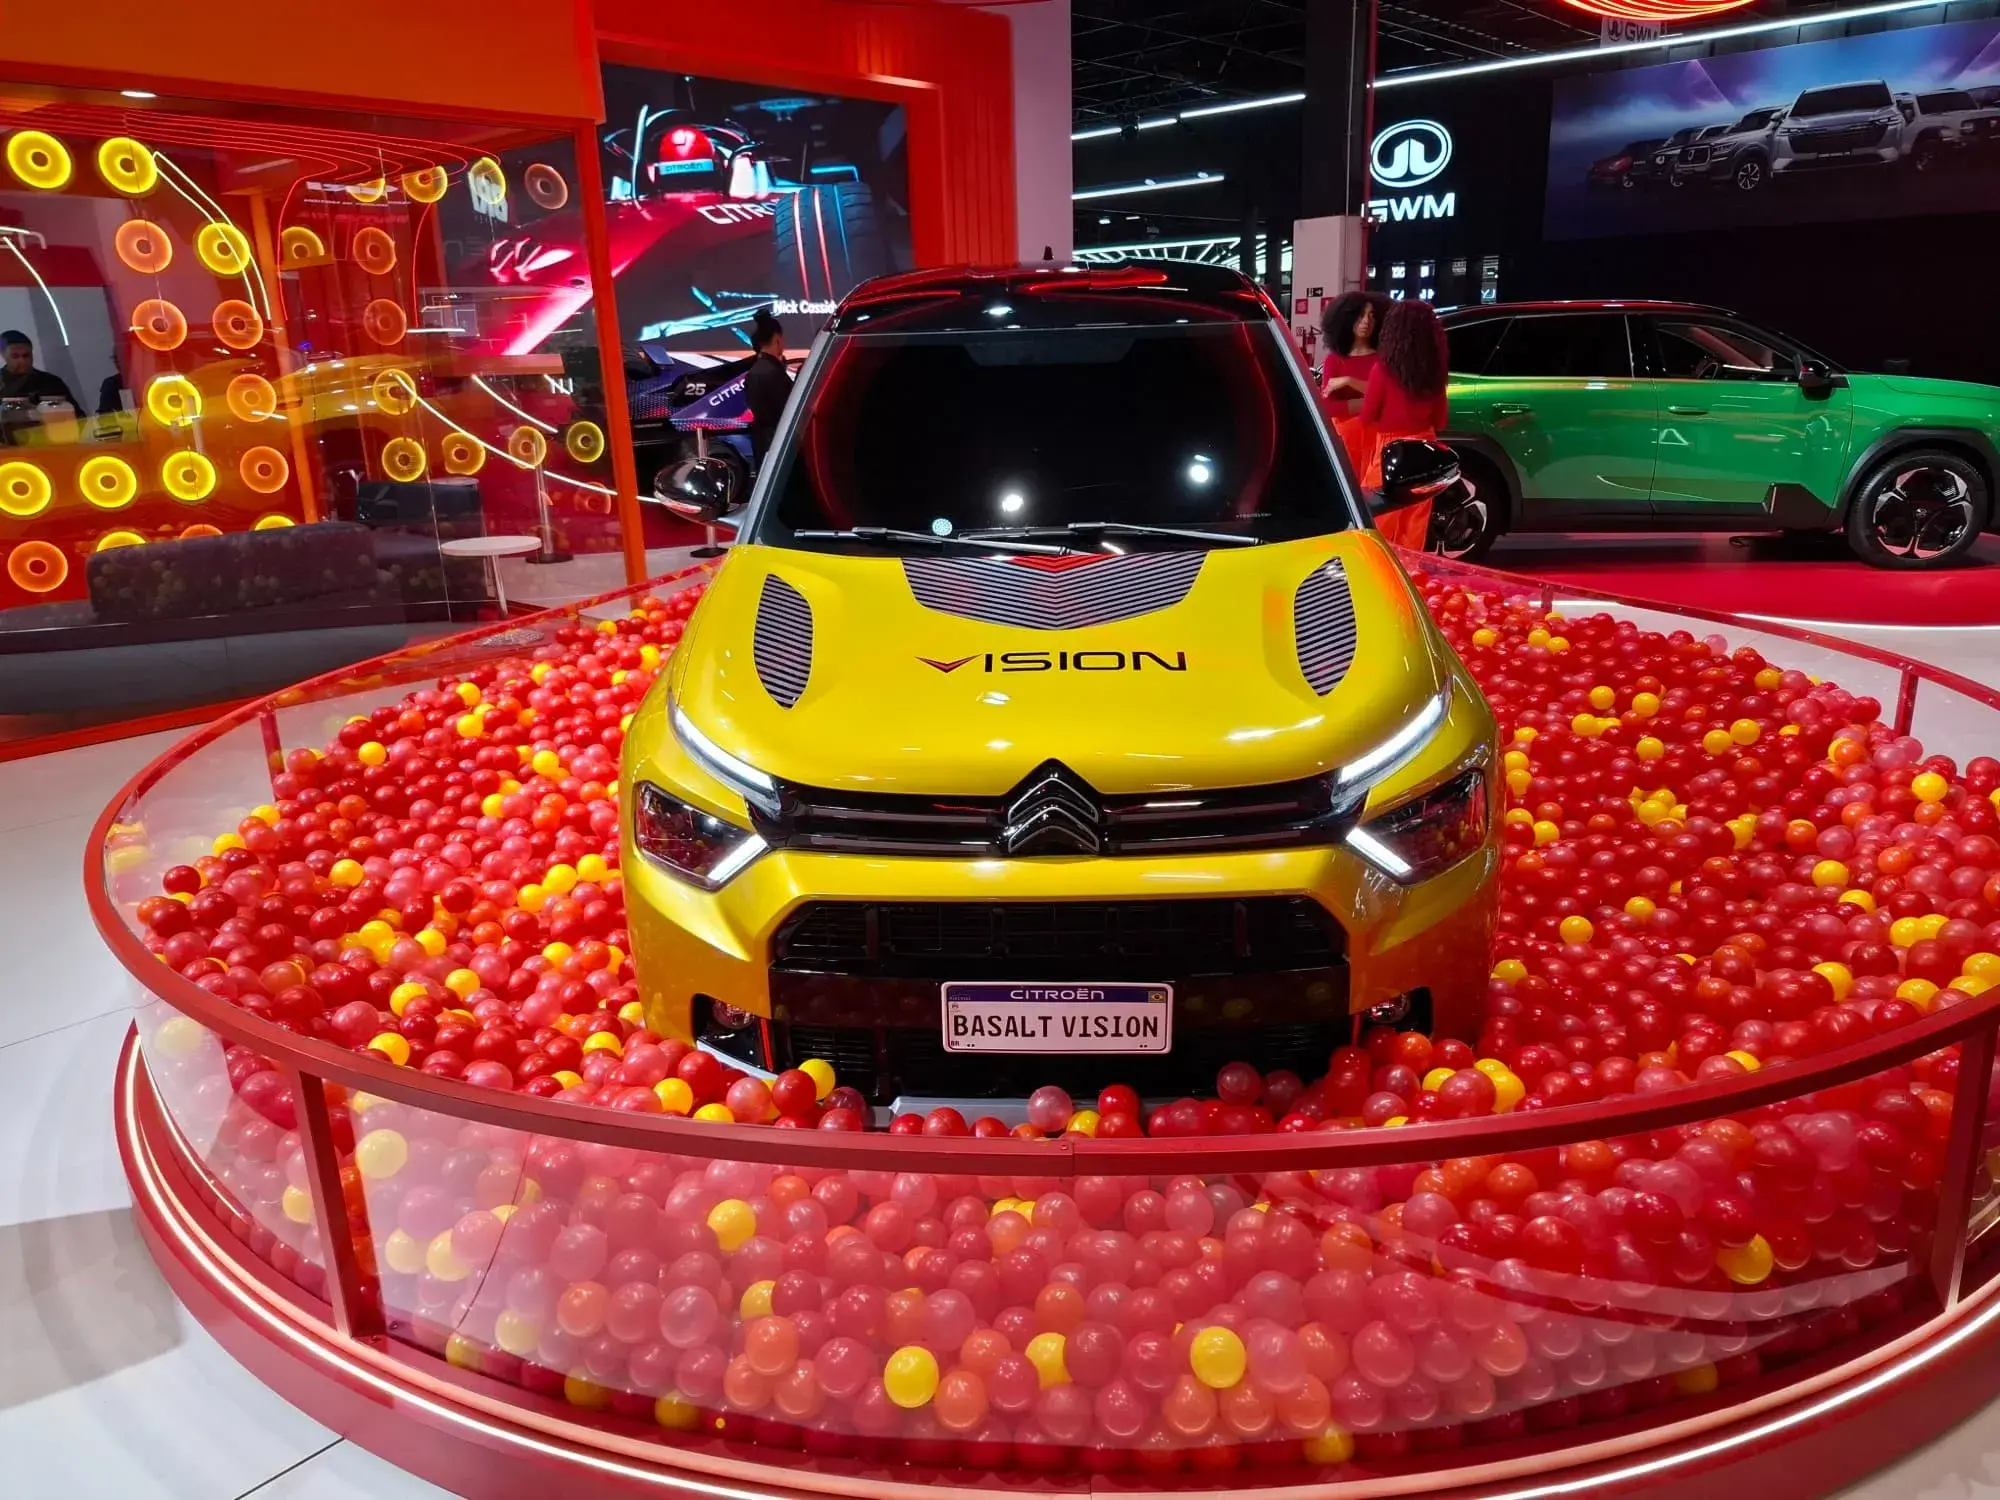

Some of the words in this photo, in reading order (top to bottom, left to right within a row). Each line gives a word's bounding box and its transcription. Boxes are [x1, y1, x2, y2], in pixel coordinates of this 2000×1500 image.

[1360, 192, 1455, 223] GWM
[772, 299, 799, 314] Nick
[684, 383, 707, 396] 25
[914, 651, 1187, 673] VISION
[953, 1014, 1053, 1038] BASALT
[1062, 1015, 1158, 1038] VISION
